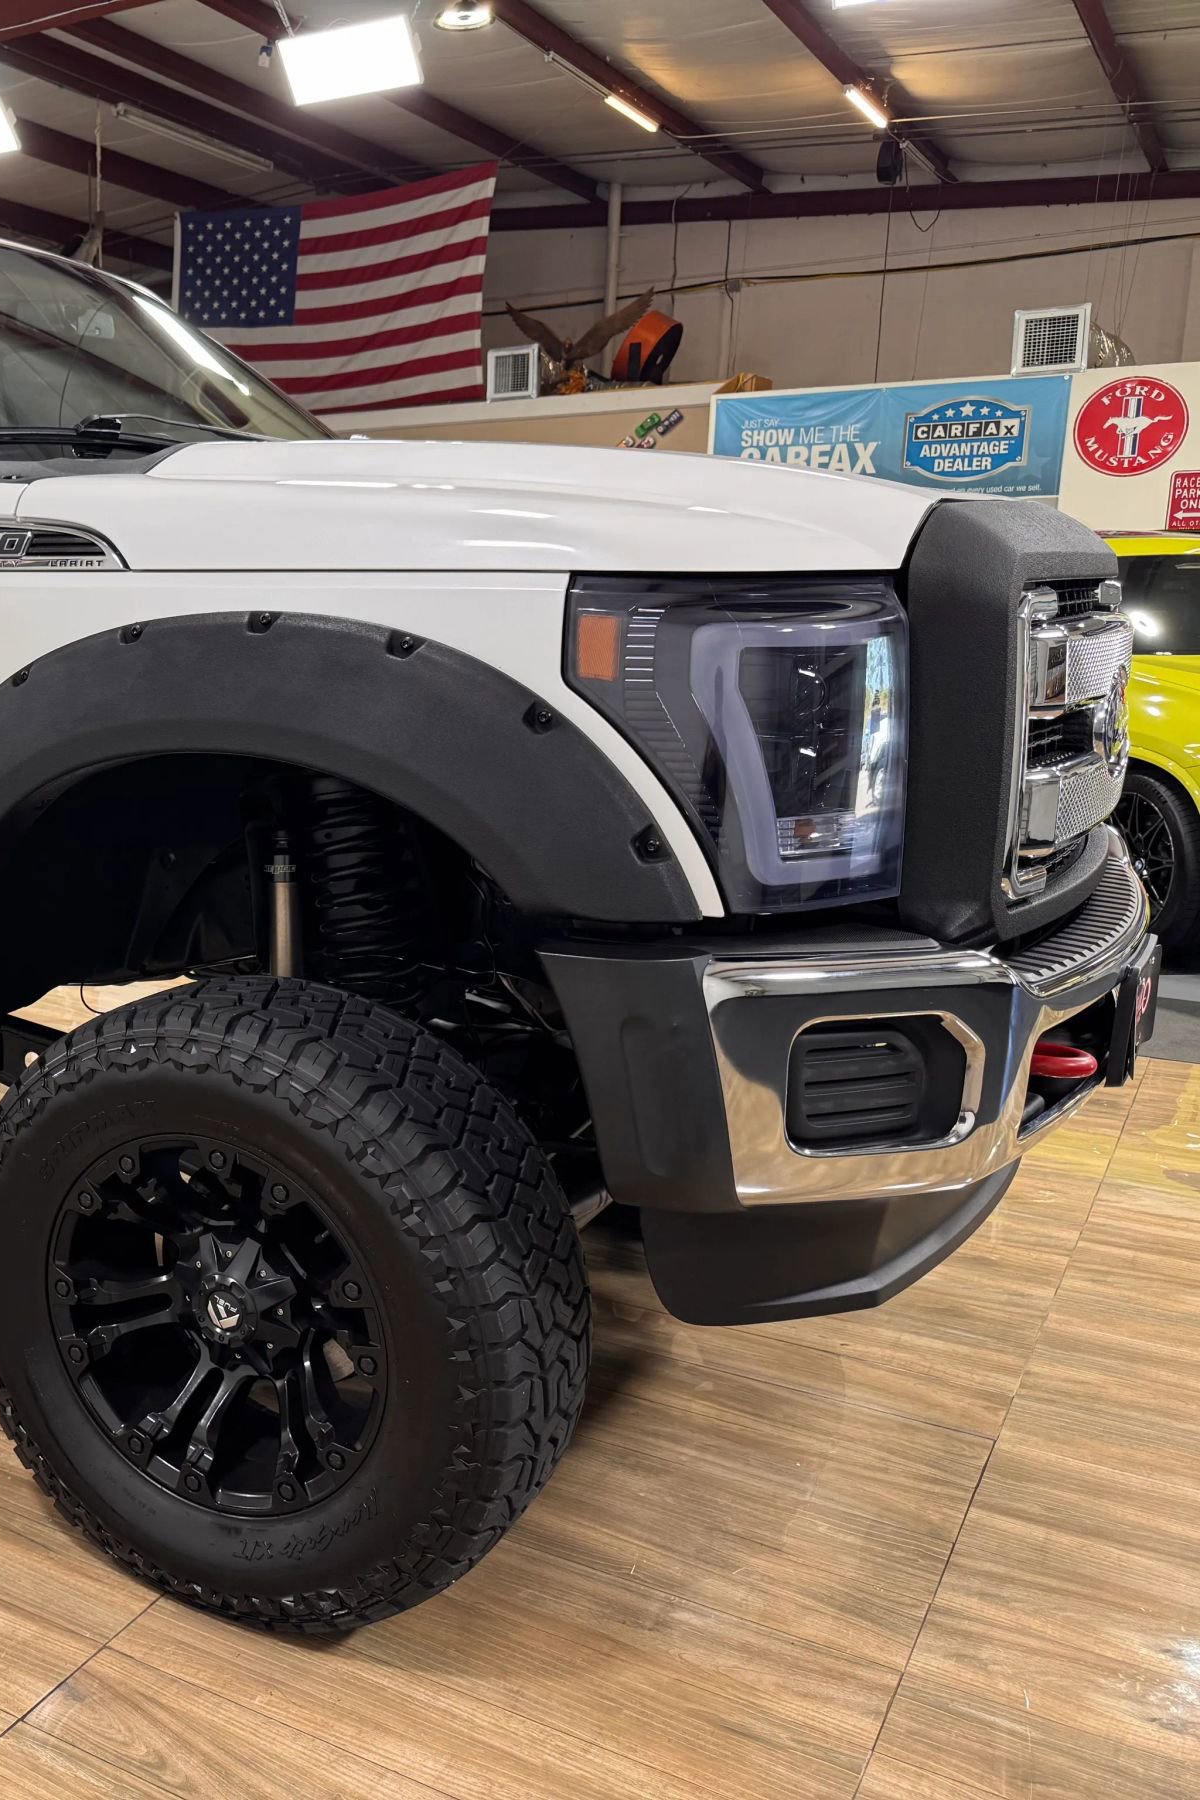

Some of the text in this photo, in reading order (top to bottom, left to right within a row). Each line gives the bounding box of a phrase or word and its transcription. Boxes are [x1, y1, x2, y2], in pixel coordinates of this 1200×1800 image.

[1101, 385, 1165, 406] FORD
[741, 418, 780, 429] JUST SAY
[916, 422, 1016, 439] CARFAX
[740, 424, 861, 447] SHOW ME THE
[1085, 432, 1175, 468] MUSTANG
[934, 457, 992, 473] DEALER
[986, 485, 1002, 493] used
[49, 559, 105, 568] LARIAT
